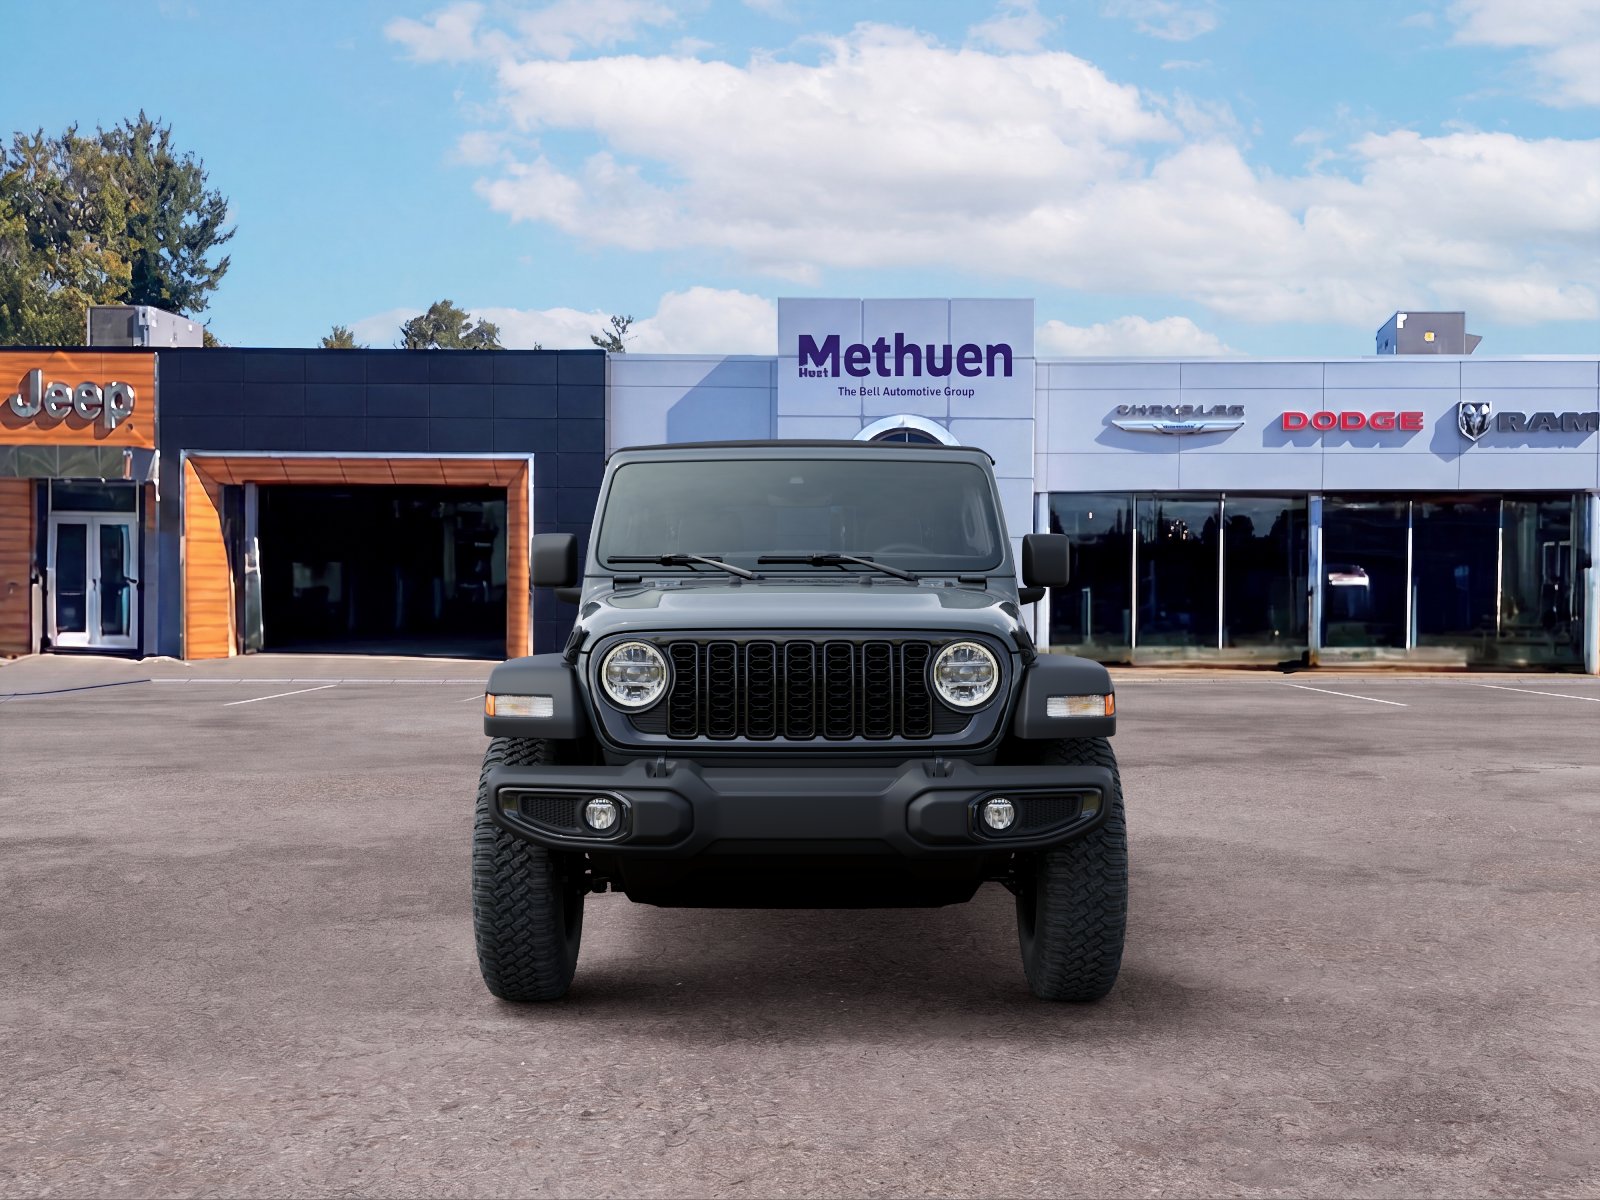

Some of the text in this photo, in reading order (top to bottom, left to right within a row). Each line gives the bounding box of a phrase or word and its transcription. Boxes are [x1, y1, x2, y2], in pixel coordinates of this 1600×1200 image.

[798, 332, 1013, 378] Methuen
[9, 368, 135, 429] Jeep
[838, 386, 975, 399] The Bell Automotive Group
[1282, 411, 1424, 431] DODGE
[1497, 411, 1599, 432] RAM
